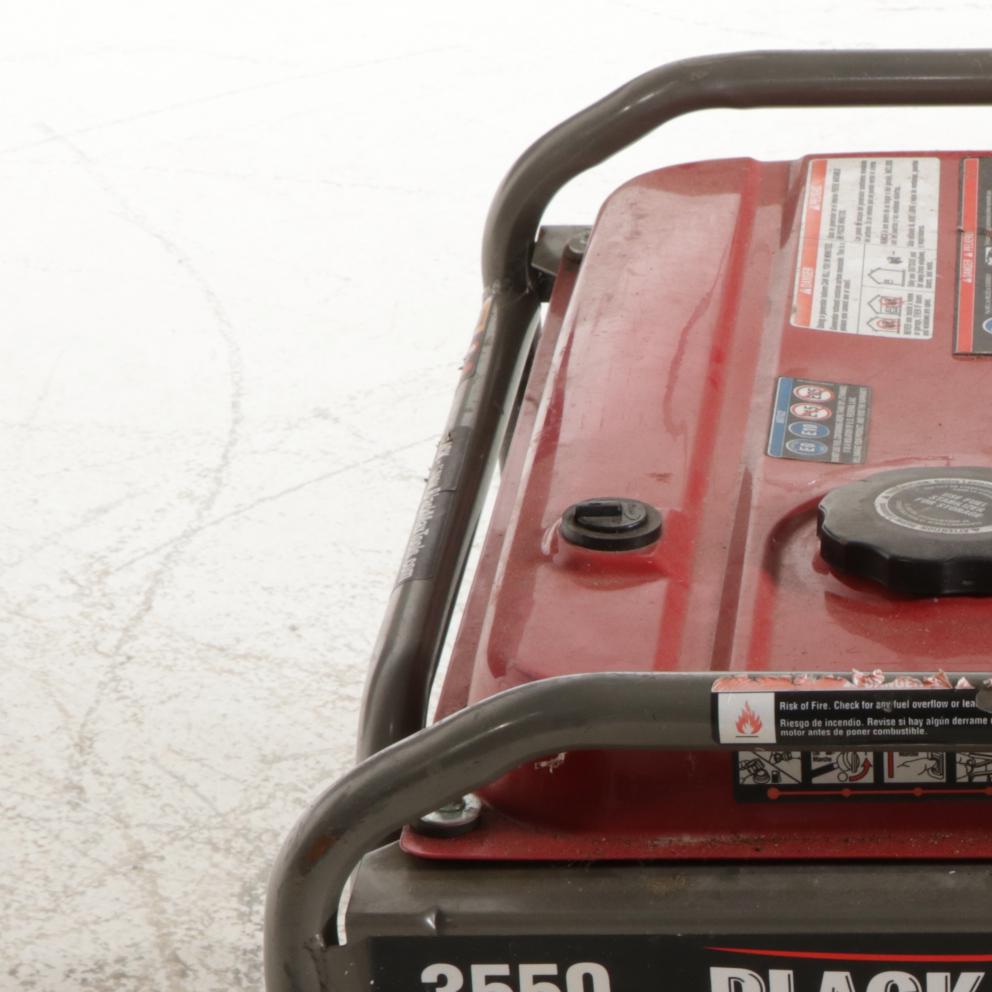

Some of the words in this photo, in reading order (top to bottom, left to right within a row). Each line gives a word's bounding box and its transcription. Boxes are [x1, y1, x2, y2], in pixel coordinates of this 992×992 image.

[779, 701, 798, 711] Risk
[800, 701, 810, 710] of
[811, 701, 831, 710] Fire.
[833, 700, 860, 710] Check
[861, 700, 874, 709] for
[876, 701, 892, 711] any
[893, 700, 910, 709] fuel
[912, 699, 949, 709] overflow
[951, 701, 961, 709] or
[962, 699, 976, 708] lea
[779, 719, 810, 729] Riesgo
[811, 718, 823, 727] de
[824, 718, 864, 728] incendio.
[867, 717, 896, 727] Revise
[898, 717, 906, 726] si
[908, 717, 923, 728] hay
[925, 716, 950, 728] algún
[952, 716, 988, 725] derrame
[780, 729, 806, 737] motor
[807, 729, 832, 737] antes
[833, 728, 844, 737] de
[846, 729, 871, 739] poner
[872, 727, 928, 737] combustible.
